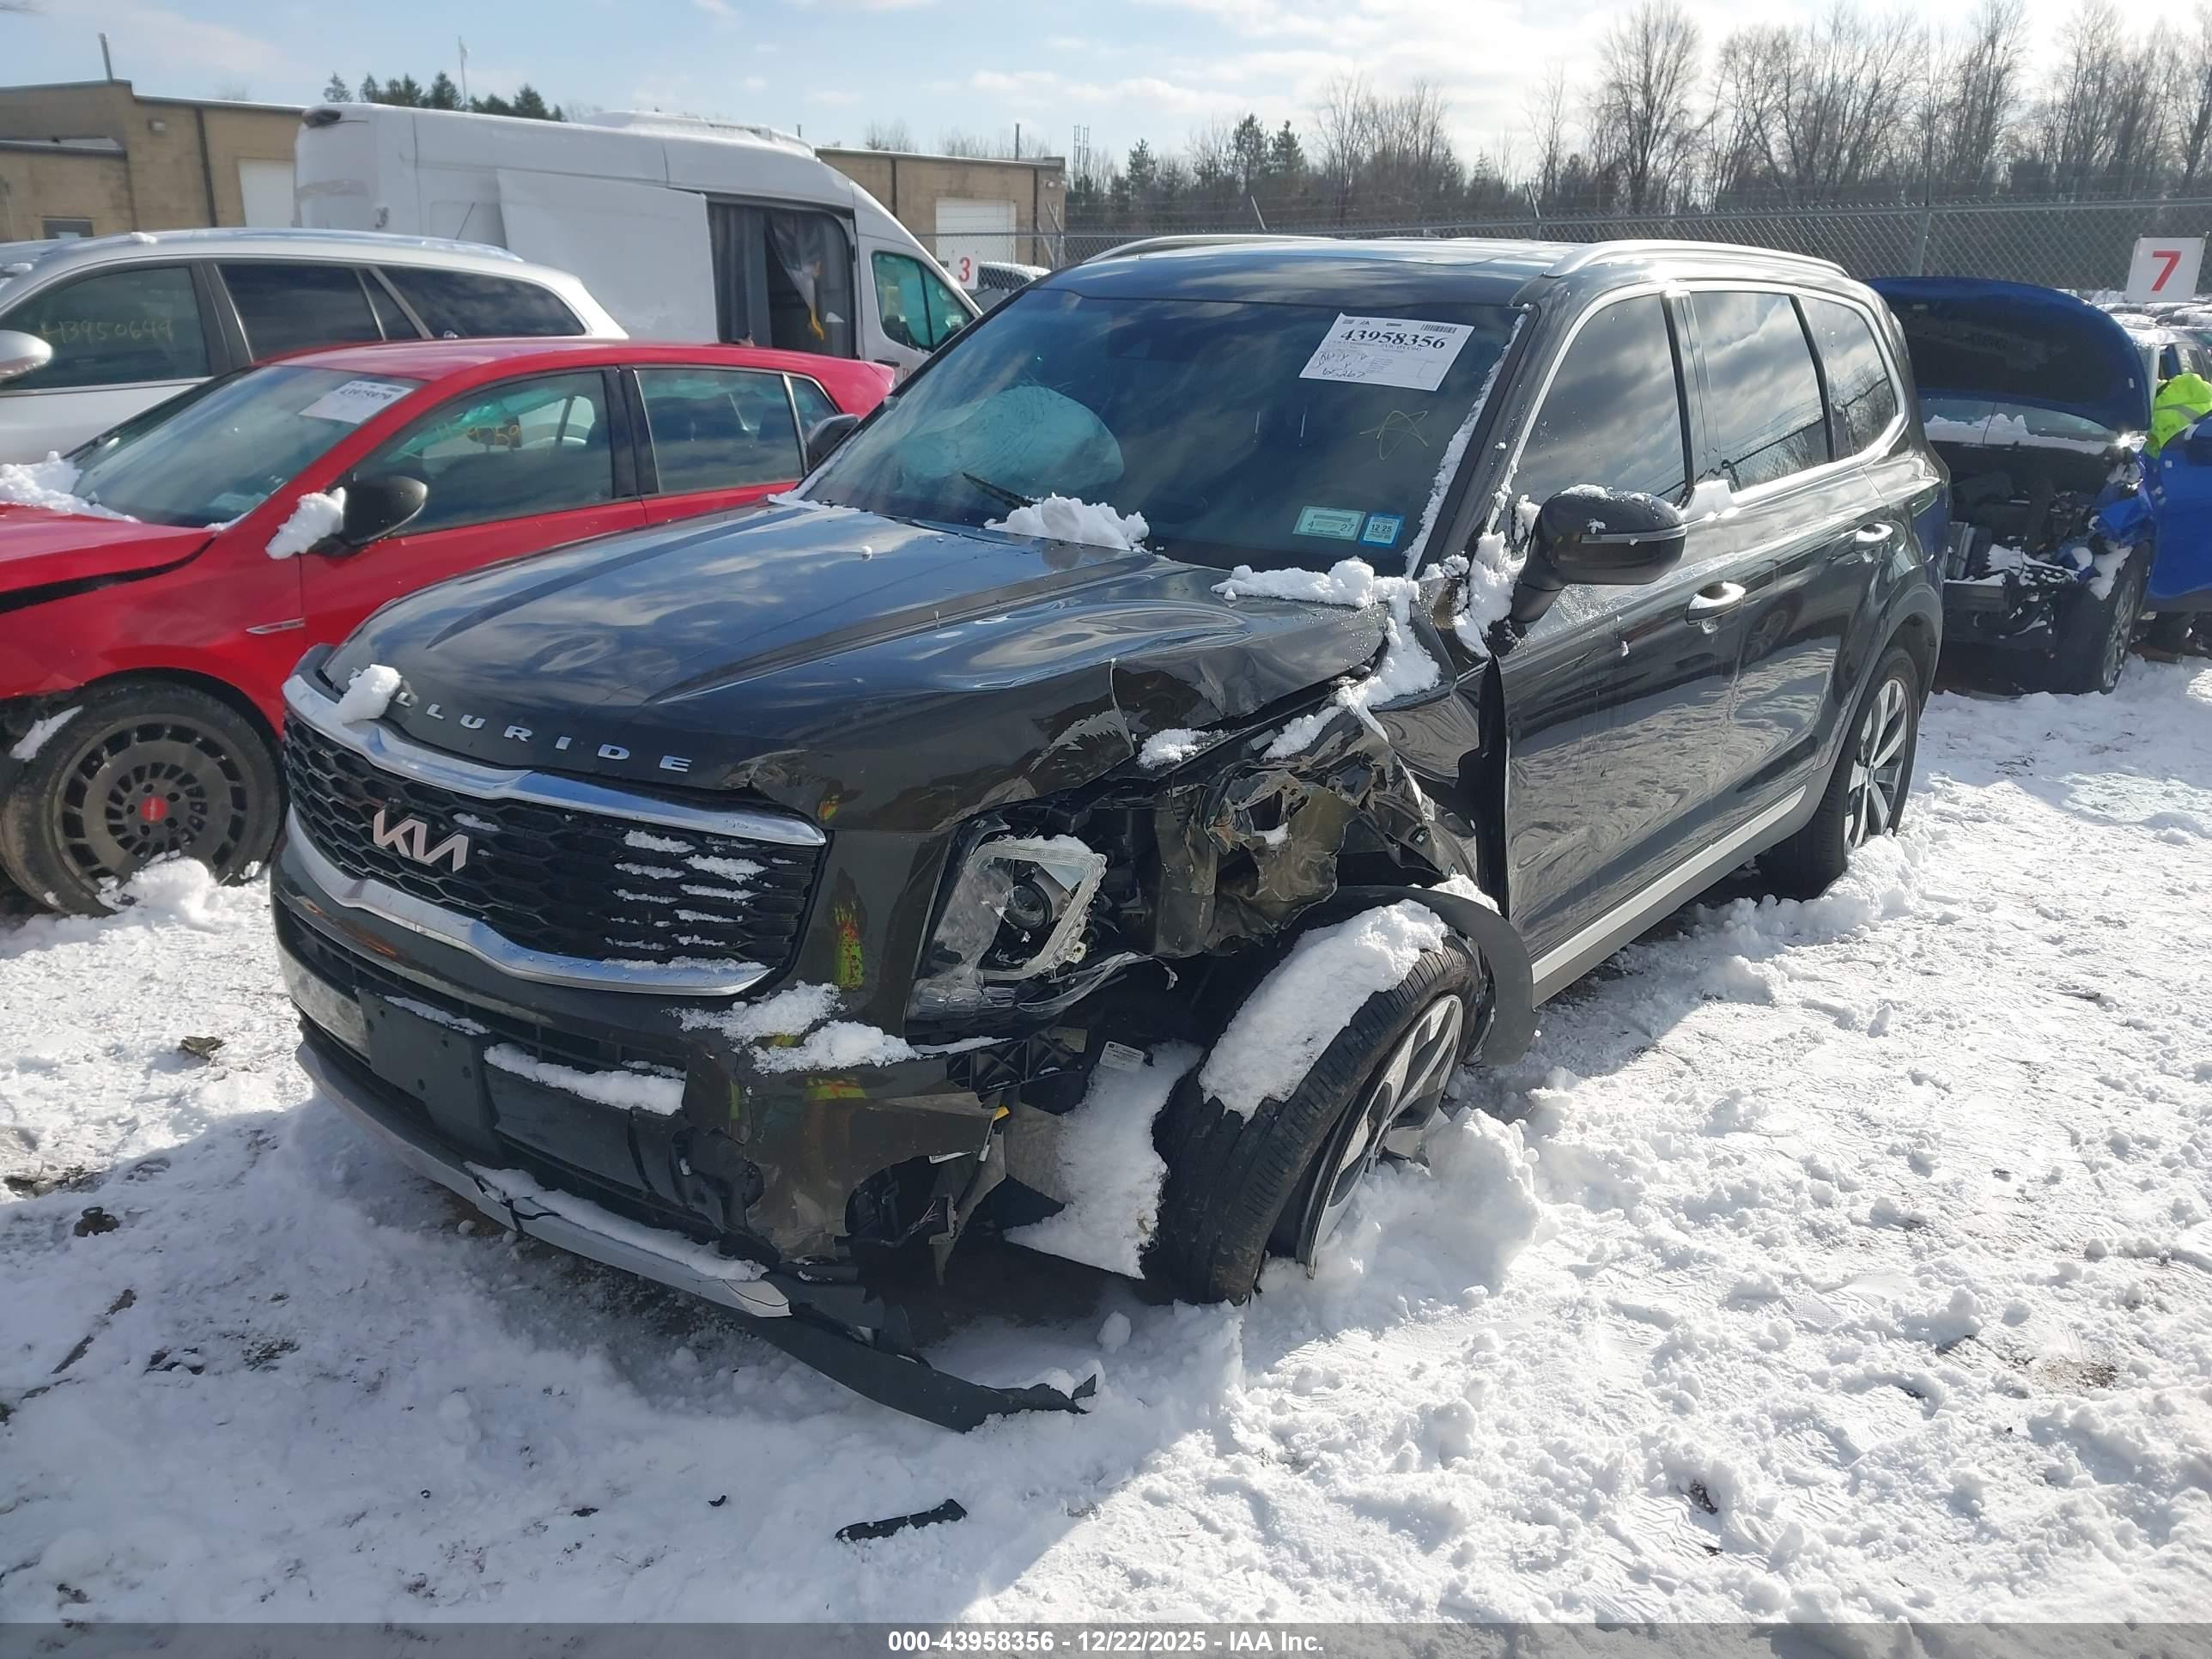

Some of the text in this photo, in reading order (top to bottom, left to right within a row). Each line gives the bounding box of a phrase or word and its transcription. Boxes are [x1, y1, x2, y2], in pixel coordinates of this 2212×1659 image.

[958, 256, 971, 283] 3
[2150, 250, 2182, 292] 7
[1340, 328, 1449, 349] 43958356
[1340, 523, 1355, 532] 27
[372, 807, 470, 873] KIA
